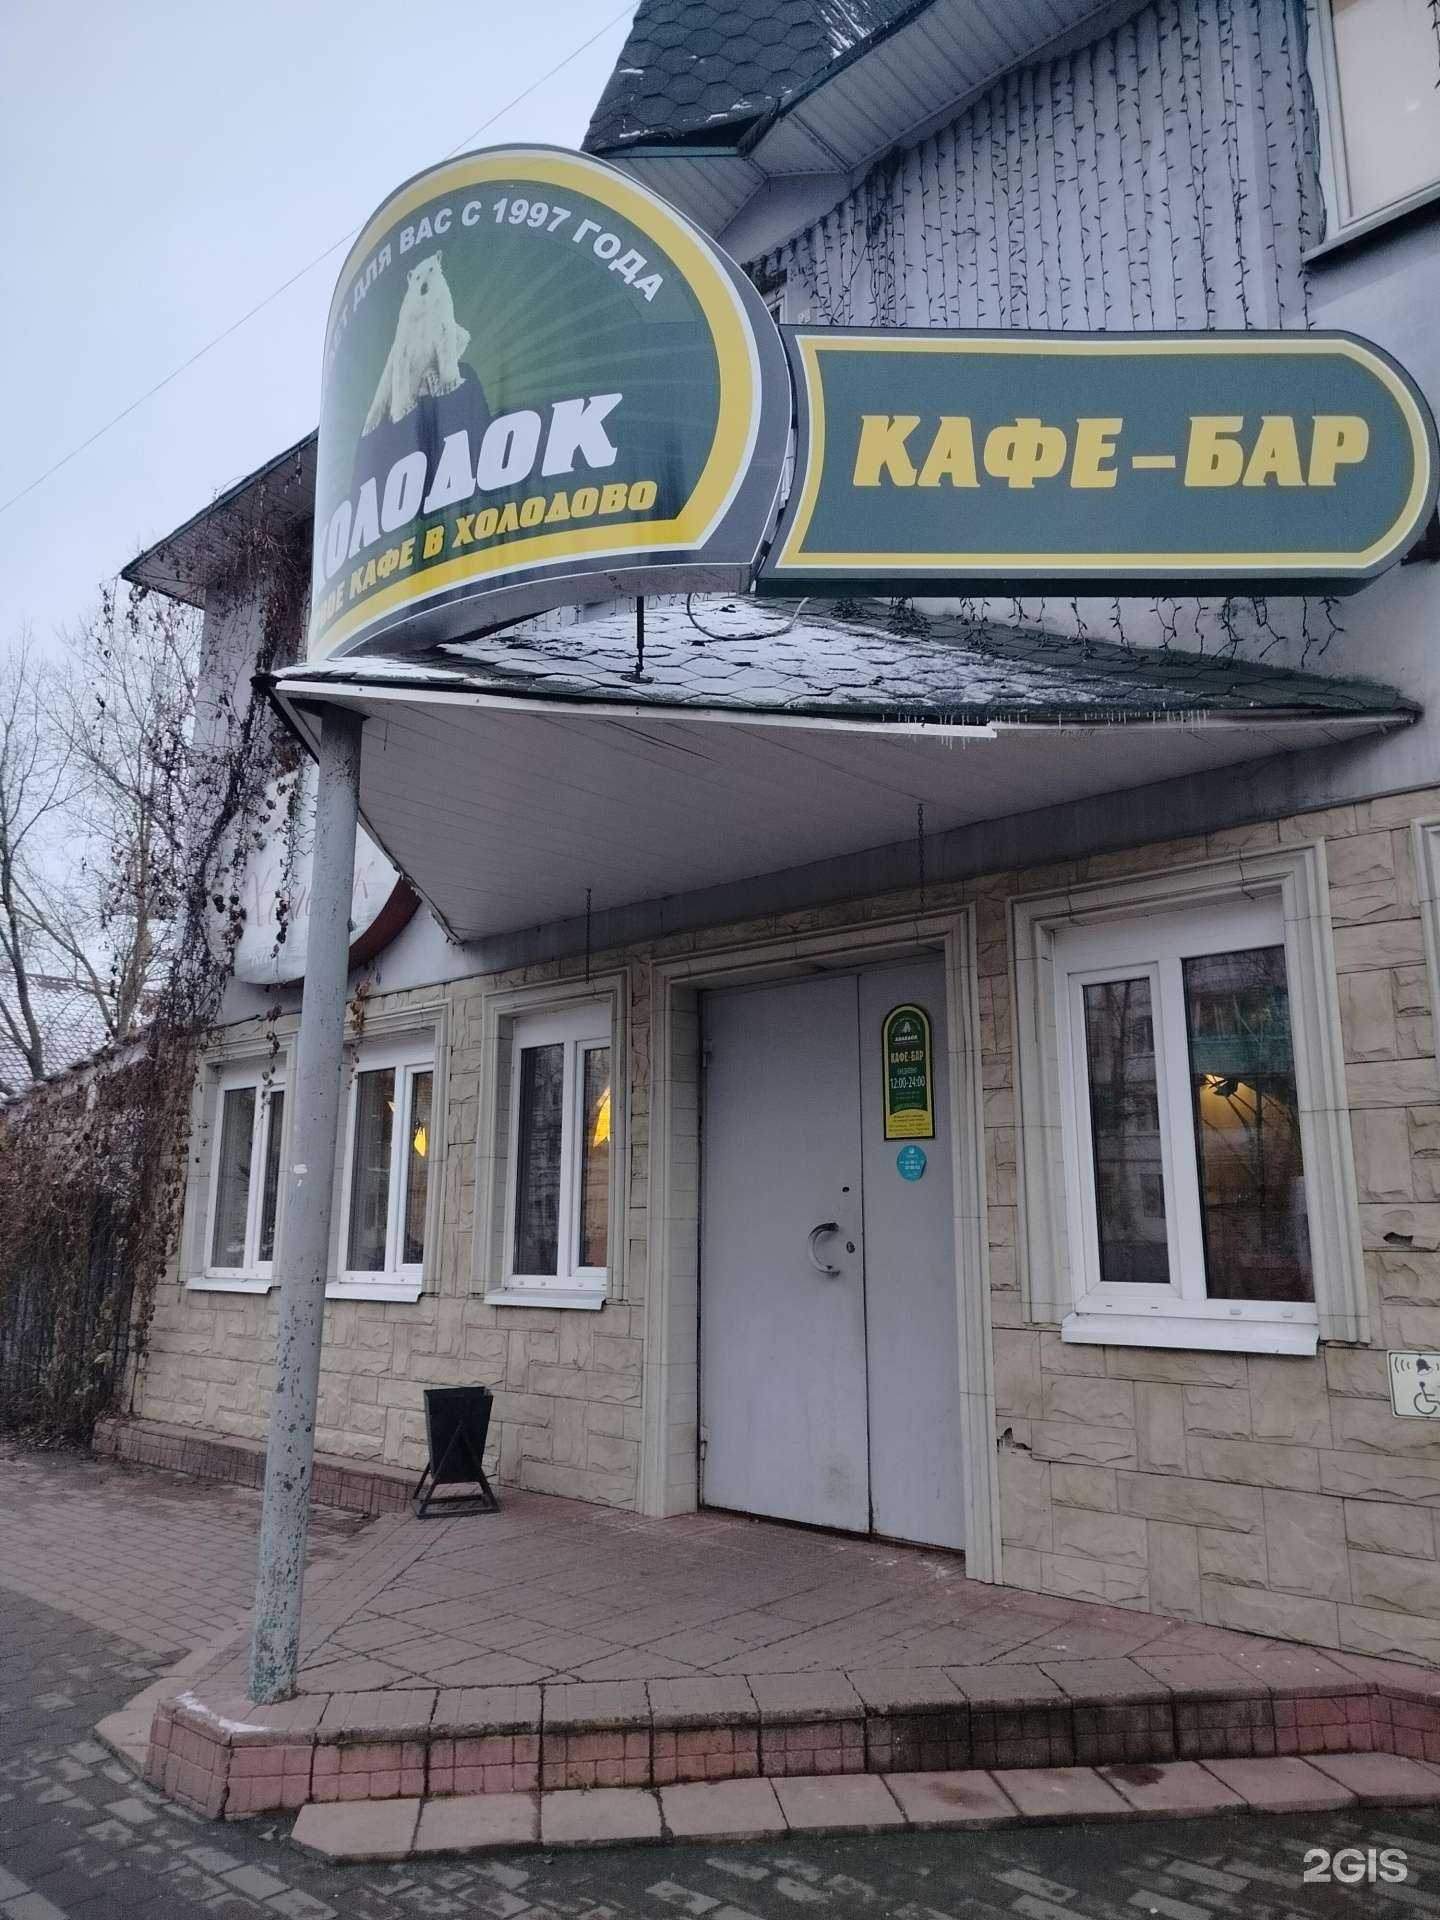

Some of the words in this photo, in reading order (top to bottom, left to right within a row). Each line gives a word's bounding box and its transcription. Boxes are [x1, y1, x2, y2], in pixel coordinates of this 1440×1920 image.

[352, 243, 392, 313] ДЛЯ
[400, 208, 453, 255] ВАС
[461, 200, 482, 226] С
[493, 198, 571, 232] 1997
[572, 218, 664, 303] ГОДА
[852, 415, 1371, 489] КАФЕ-БАР
[349, 536, 417, 600] КАФЕ
[422, 525, 446, 561] В
[452, 480, 659, 549] ХОЛОДОВО
[890, 1049, 925, 1064] КАФЕ-БАР
[890, 1075, 927, 1089] 12:00-24:00
